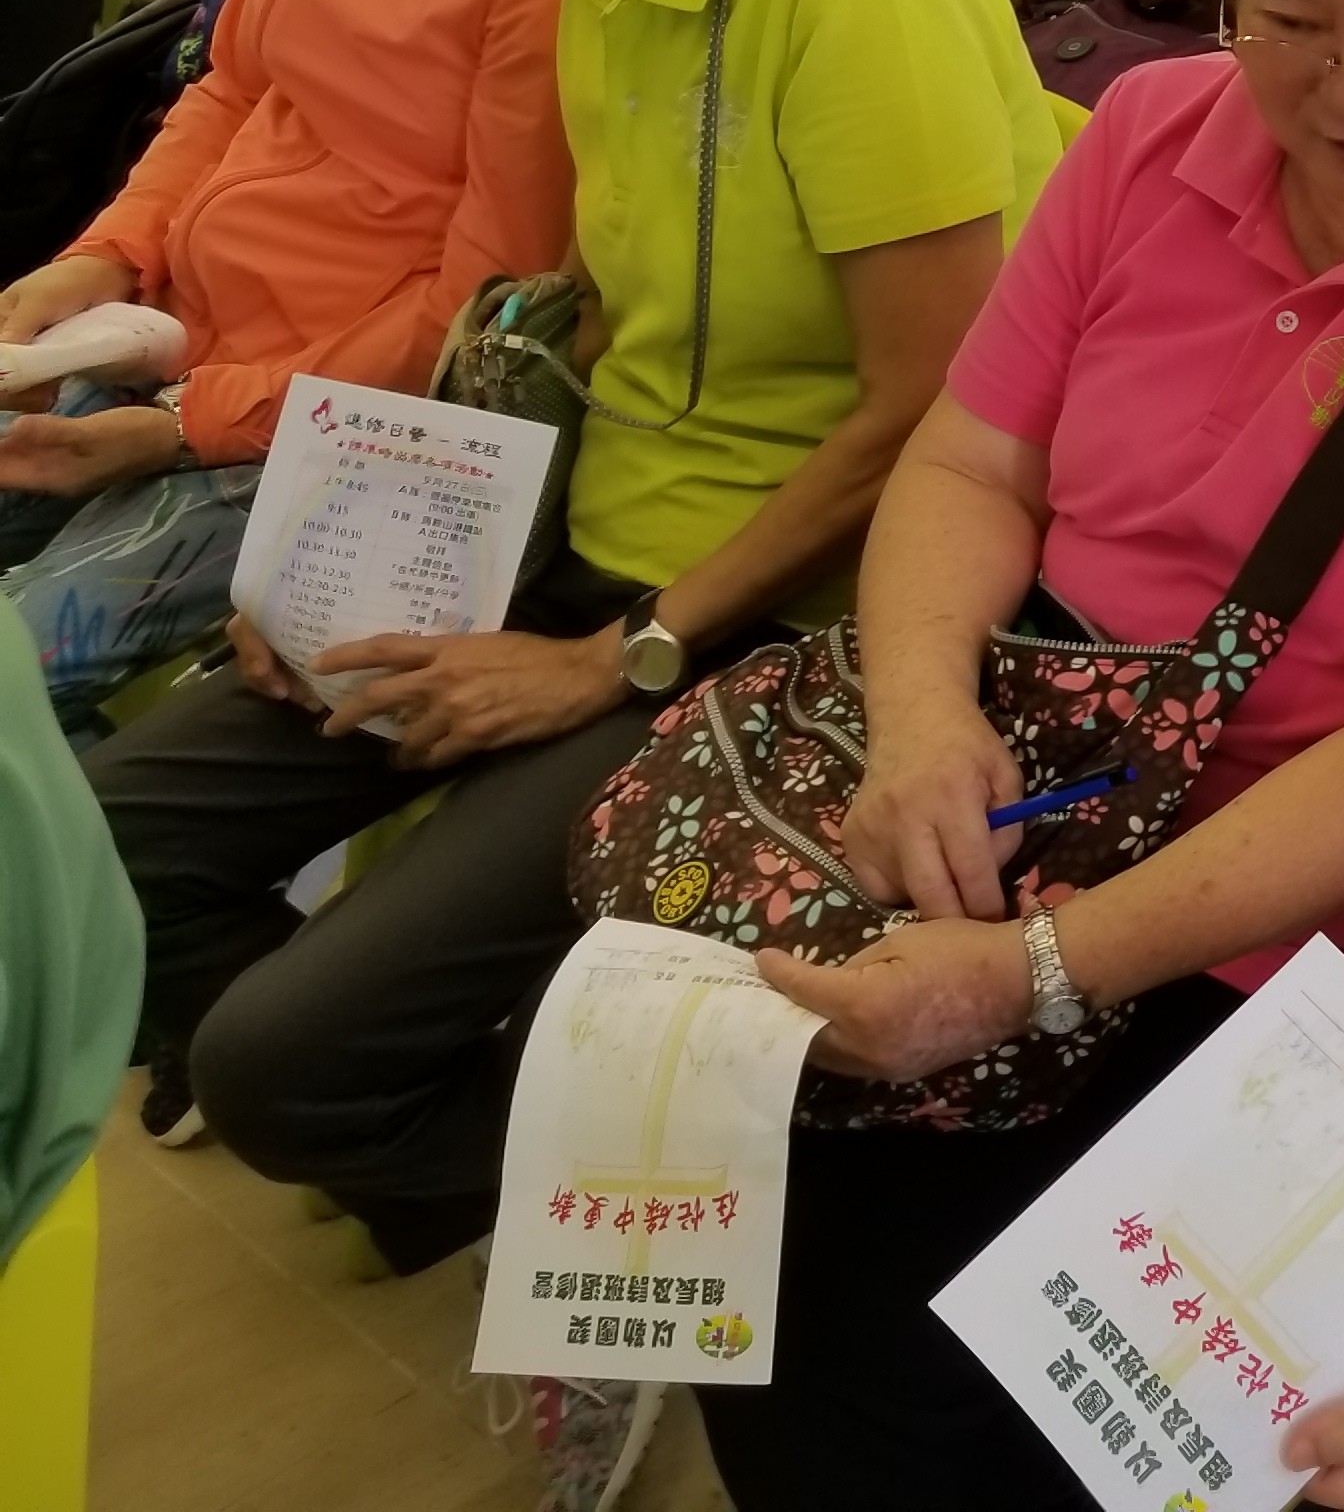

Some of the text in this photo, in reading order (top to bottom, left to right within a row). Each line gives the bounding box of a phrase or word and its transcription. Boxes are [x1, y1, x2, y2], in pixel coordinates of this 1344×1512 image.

[548, 1184, 742, 1235] 在忙碌中更新
[531, 1270, 727, 1307] 組長及詩班退修營
[566, 1314, 677, 1349] 以勒團契
[1111, 1211, 1310, 1426] 在忙碌中更新
[1040, 1269, 1234, 1492] 組長及詩班退修營
[1045, 1347, 1163, 1485] 以勒團契
